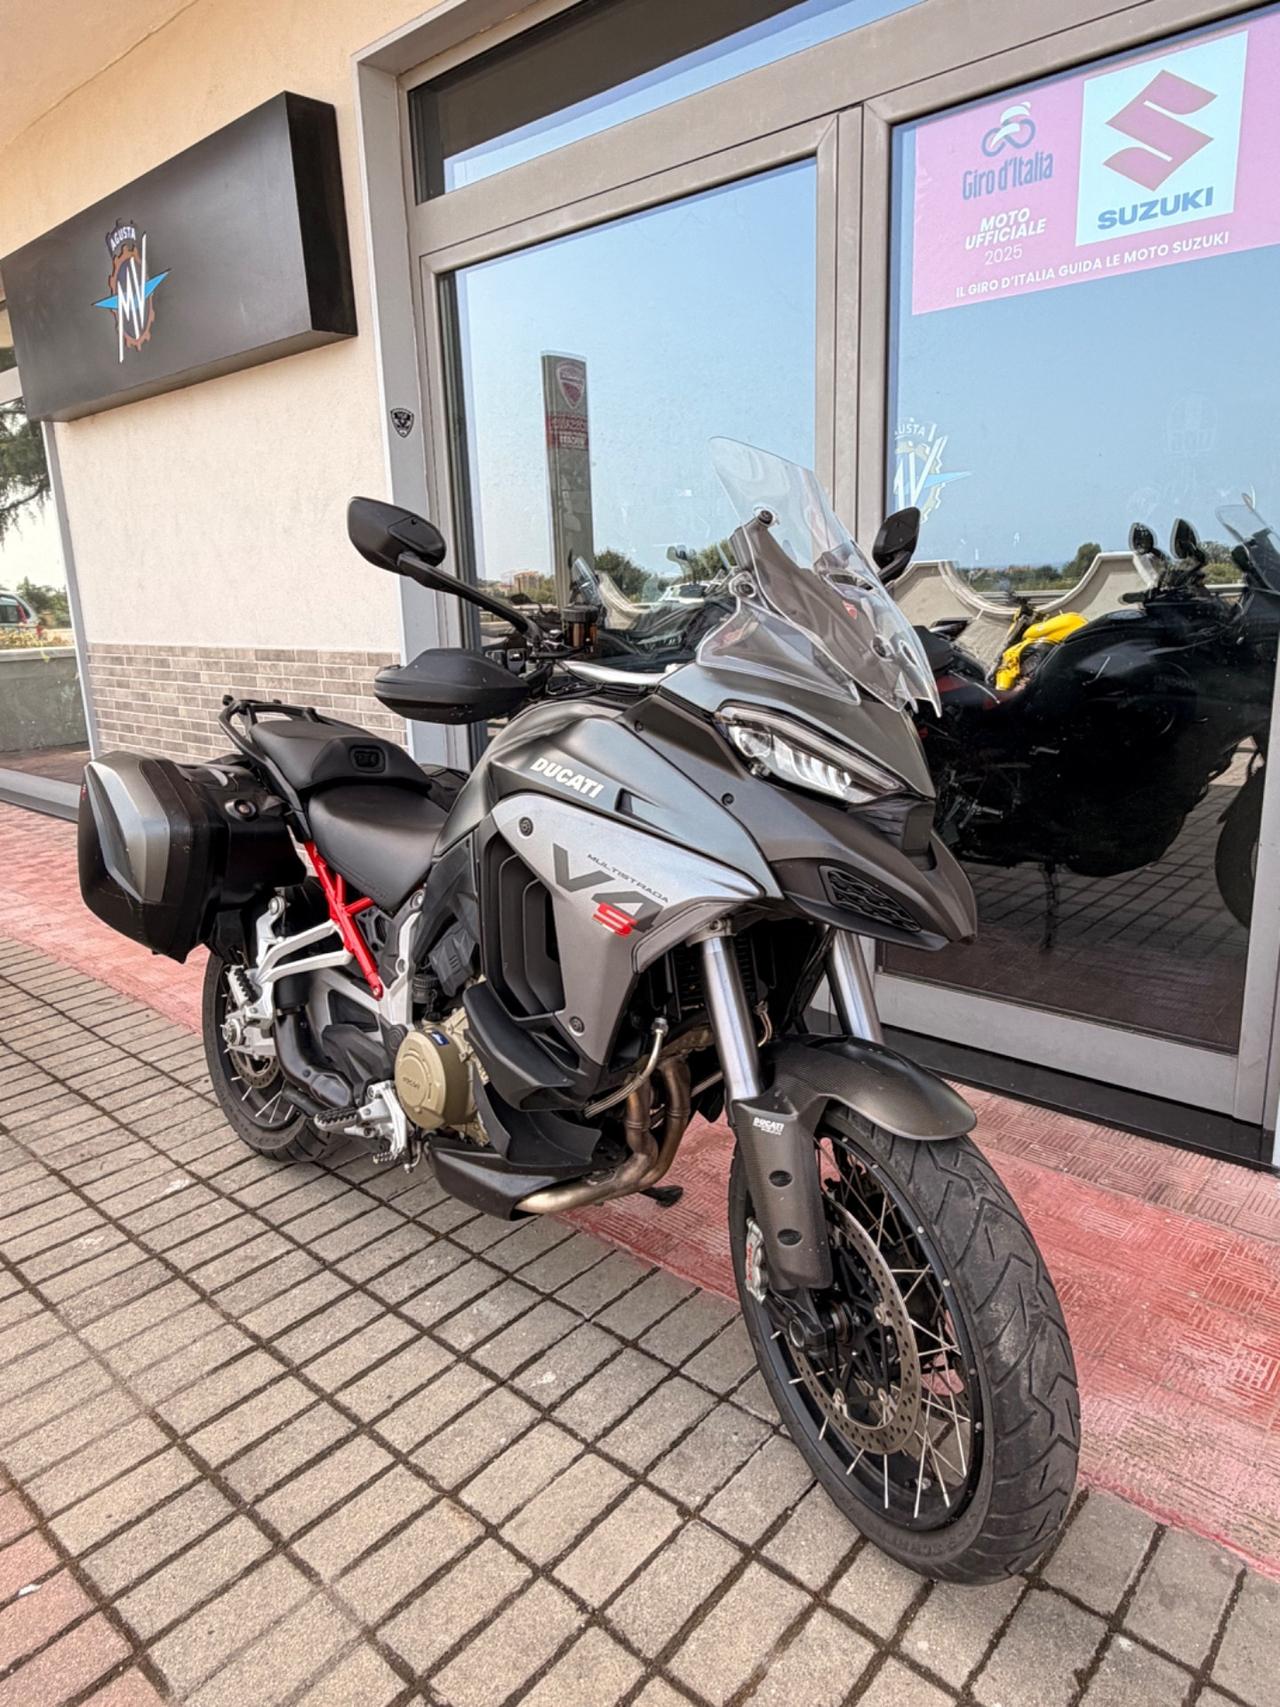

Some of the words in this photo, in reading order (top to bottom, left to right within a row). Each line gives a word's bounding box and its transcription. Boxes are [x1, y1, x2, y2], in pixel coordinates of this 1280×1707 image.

[962, 169, 995, 201] Giro
[998, 151, 1054, 191] d'Italia
[980, 207, 1031, 232] MOTO
[1097, 186, 1214, 230] SUZUKI
[110, 225, 136, 252] AGUSTA
[965, 218, 1047, 250] UFFICIALE
[984, 244, 1023, 265] 2025
[956, 285, 966, 298] IL
[968, 278, 999, 296] GIRO
[1001, 267, 1055, 289] D'ITALIA
[1058, 257, 1102, 278] GUIDA
[1106, 252, 1121, 267] LE
[1123, 242, 1169, 264] MOTO
[1172, 231, 1230, 255] SUZUKI
[530, 757, 605, 799] DUCATI
[587, 853, 669, 903] MULTISTRADA
